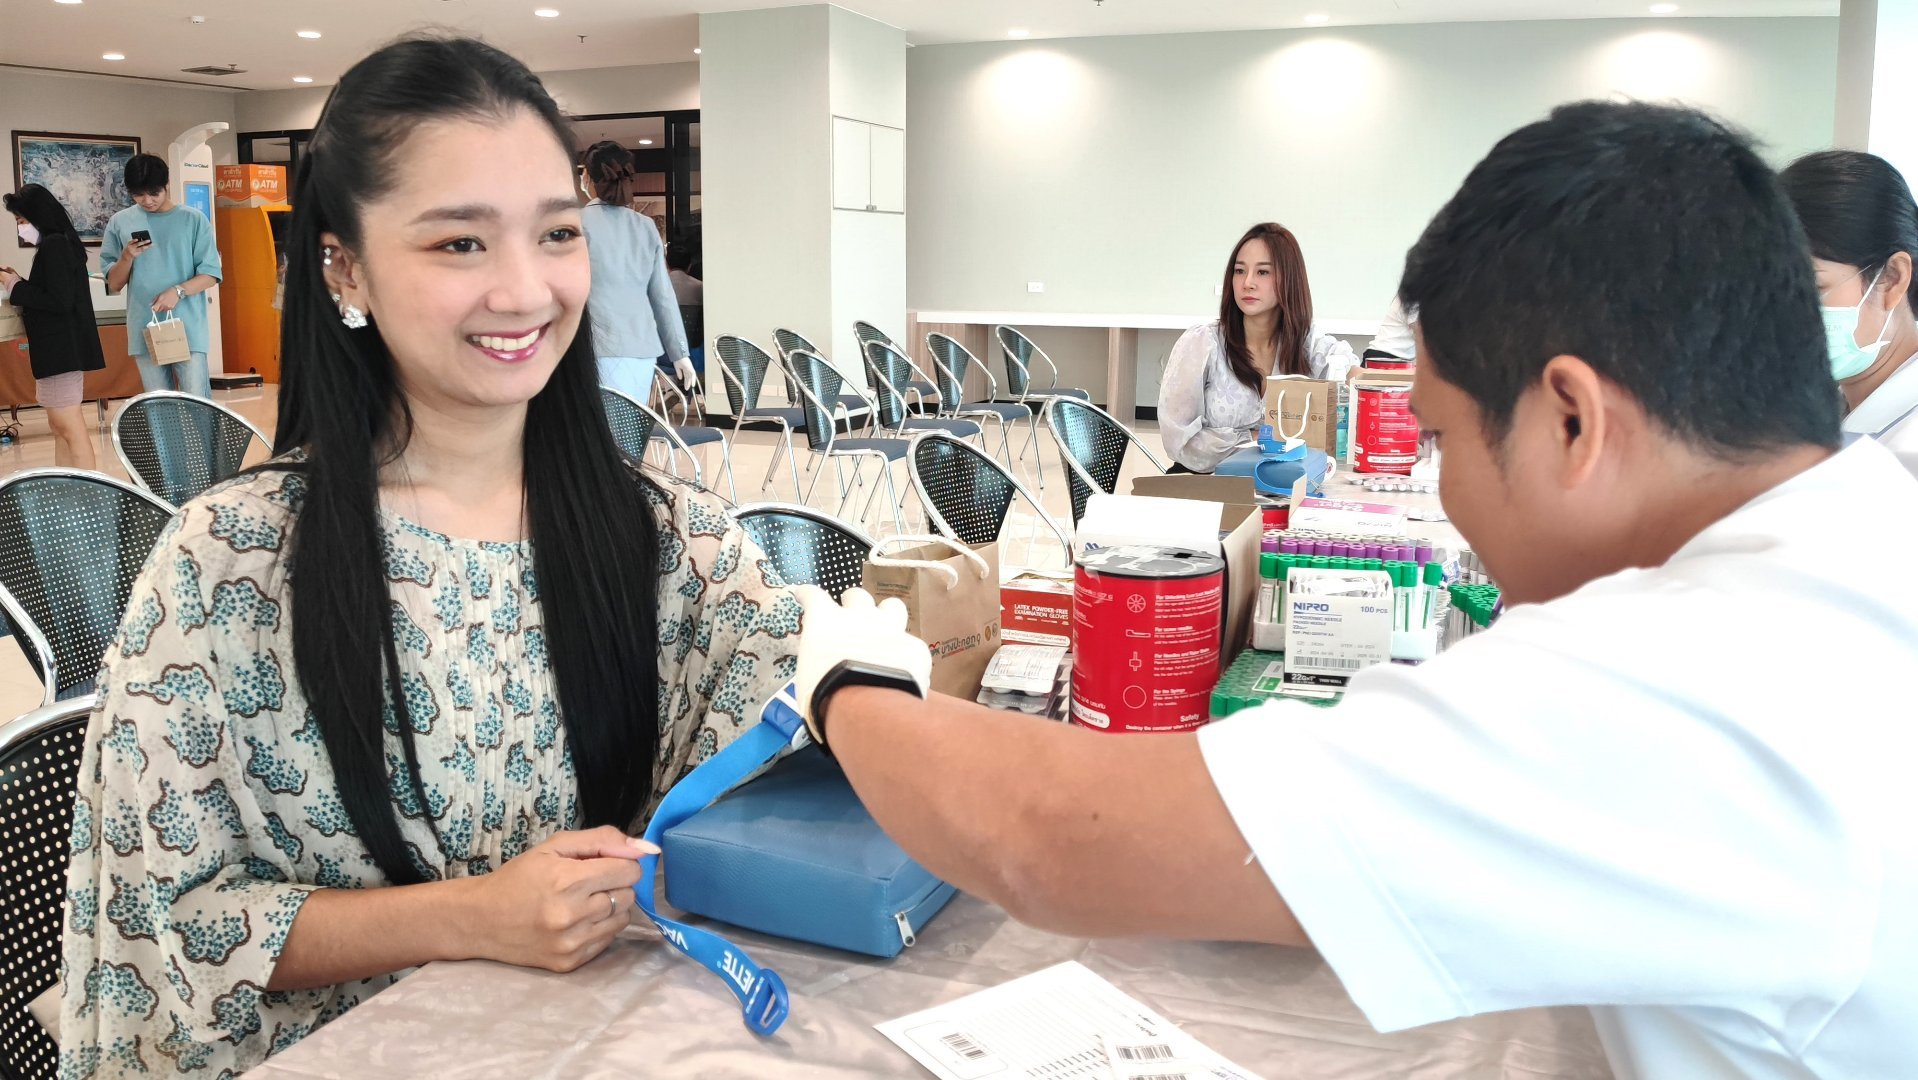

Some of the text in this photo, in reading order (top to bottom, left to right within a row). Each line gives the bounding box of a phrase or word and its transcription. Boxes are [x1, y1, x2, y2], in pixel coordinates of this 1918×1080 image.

[225, 179, 243, 188] ATM
[260, 179, 278, 189] ATM
[1014, 603, 1069, 615] LATEX POWDER-FREE
[1293, 602, 1329, 612] NIPRO
[1014, 609, 1048, 618] EXAMINATION
[1180, 713, 1200, 723] Safety
[1125, 724, 1143, 732] Destroy
